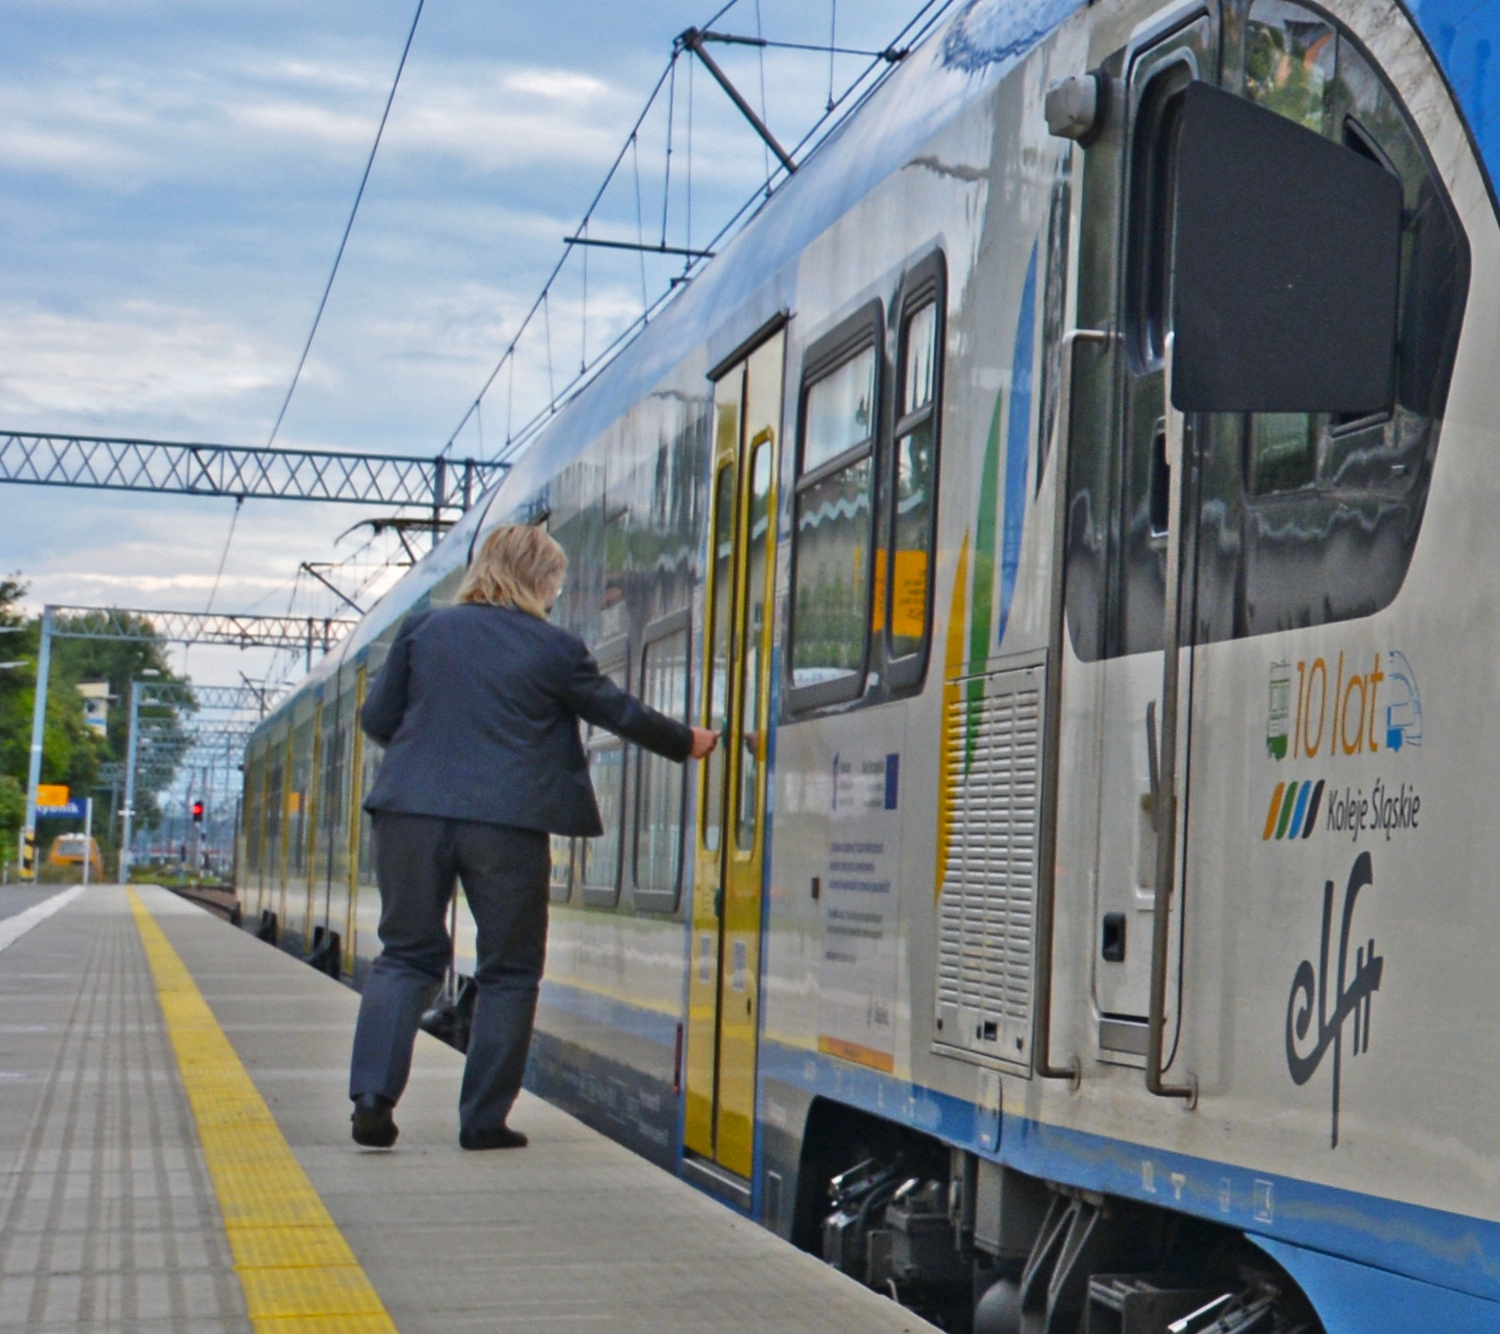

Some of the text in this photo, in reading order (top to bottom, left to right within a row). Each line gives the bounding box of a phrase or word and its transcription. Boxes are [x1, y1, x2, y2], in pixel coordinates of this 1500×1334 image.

[1294, 650, 1385, 759] 10 lat
[1326, 777, 1422, 843] Koleje Śląskie
